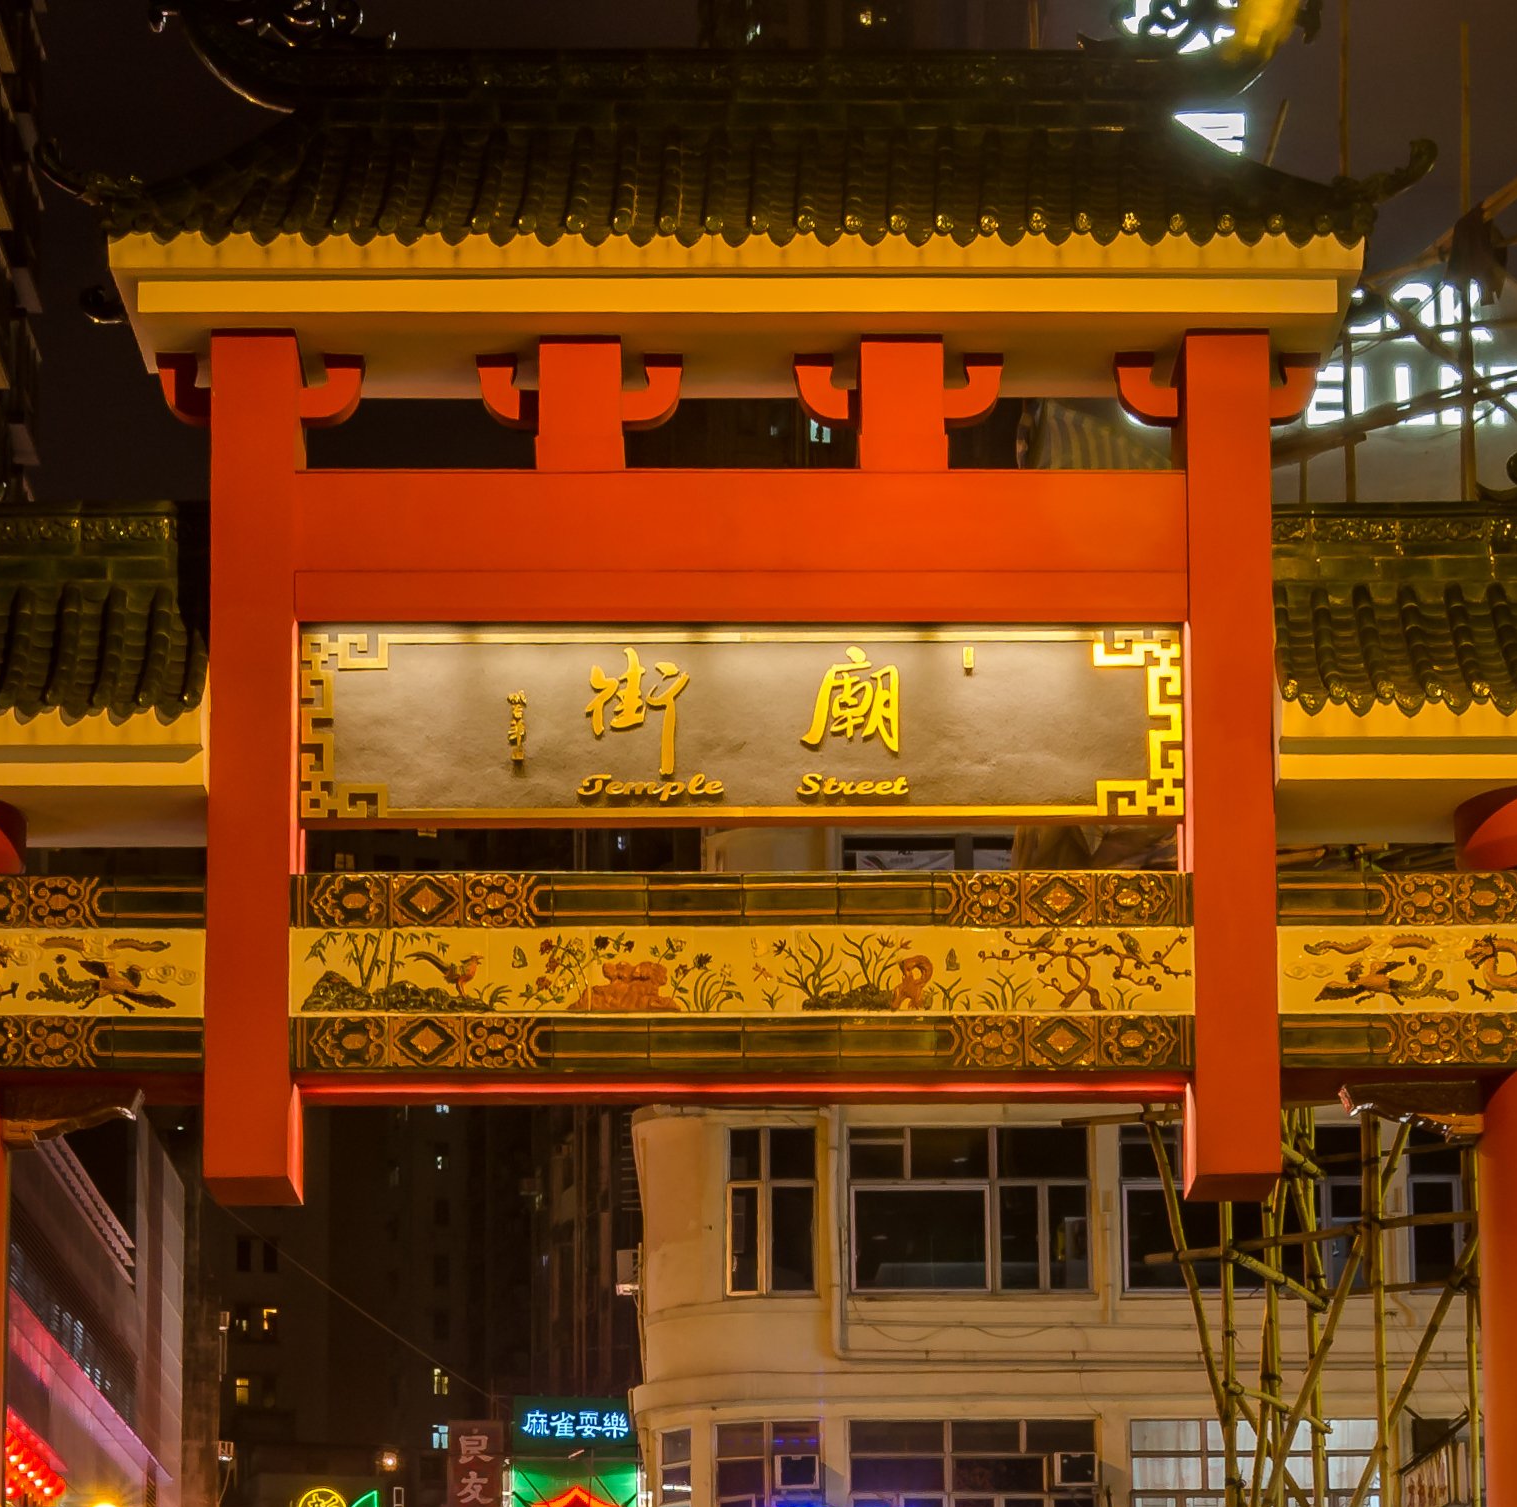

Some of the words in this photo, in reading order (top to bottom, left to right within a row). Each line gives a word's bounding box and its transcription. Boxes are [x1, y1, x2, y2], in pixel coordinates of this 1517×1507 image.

[577, 772, 725, 801] Temple
[795, 772, 909, 797] Street
[521, 1409, 629, 1439] 麻雀耍樂
